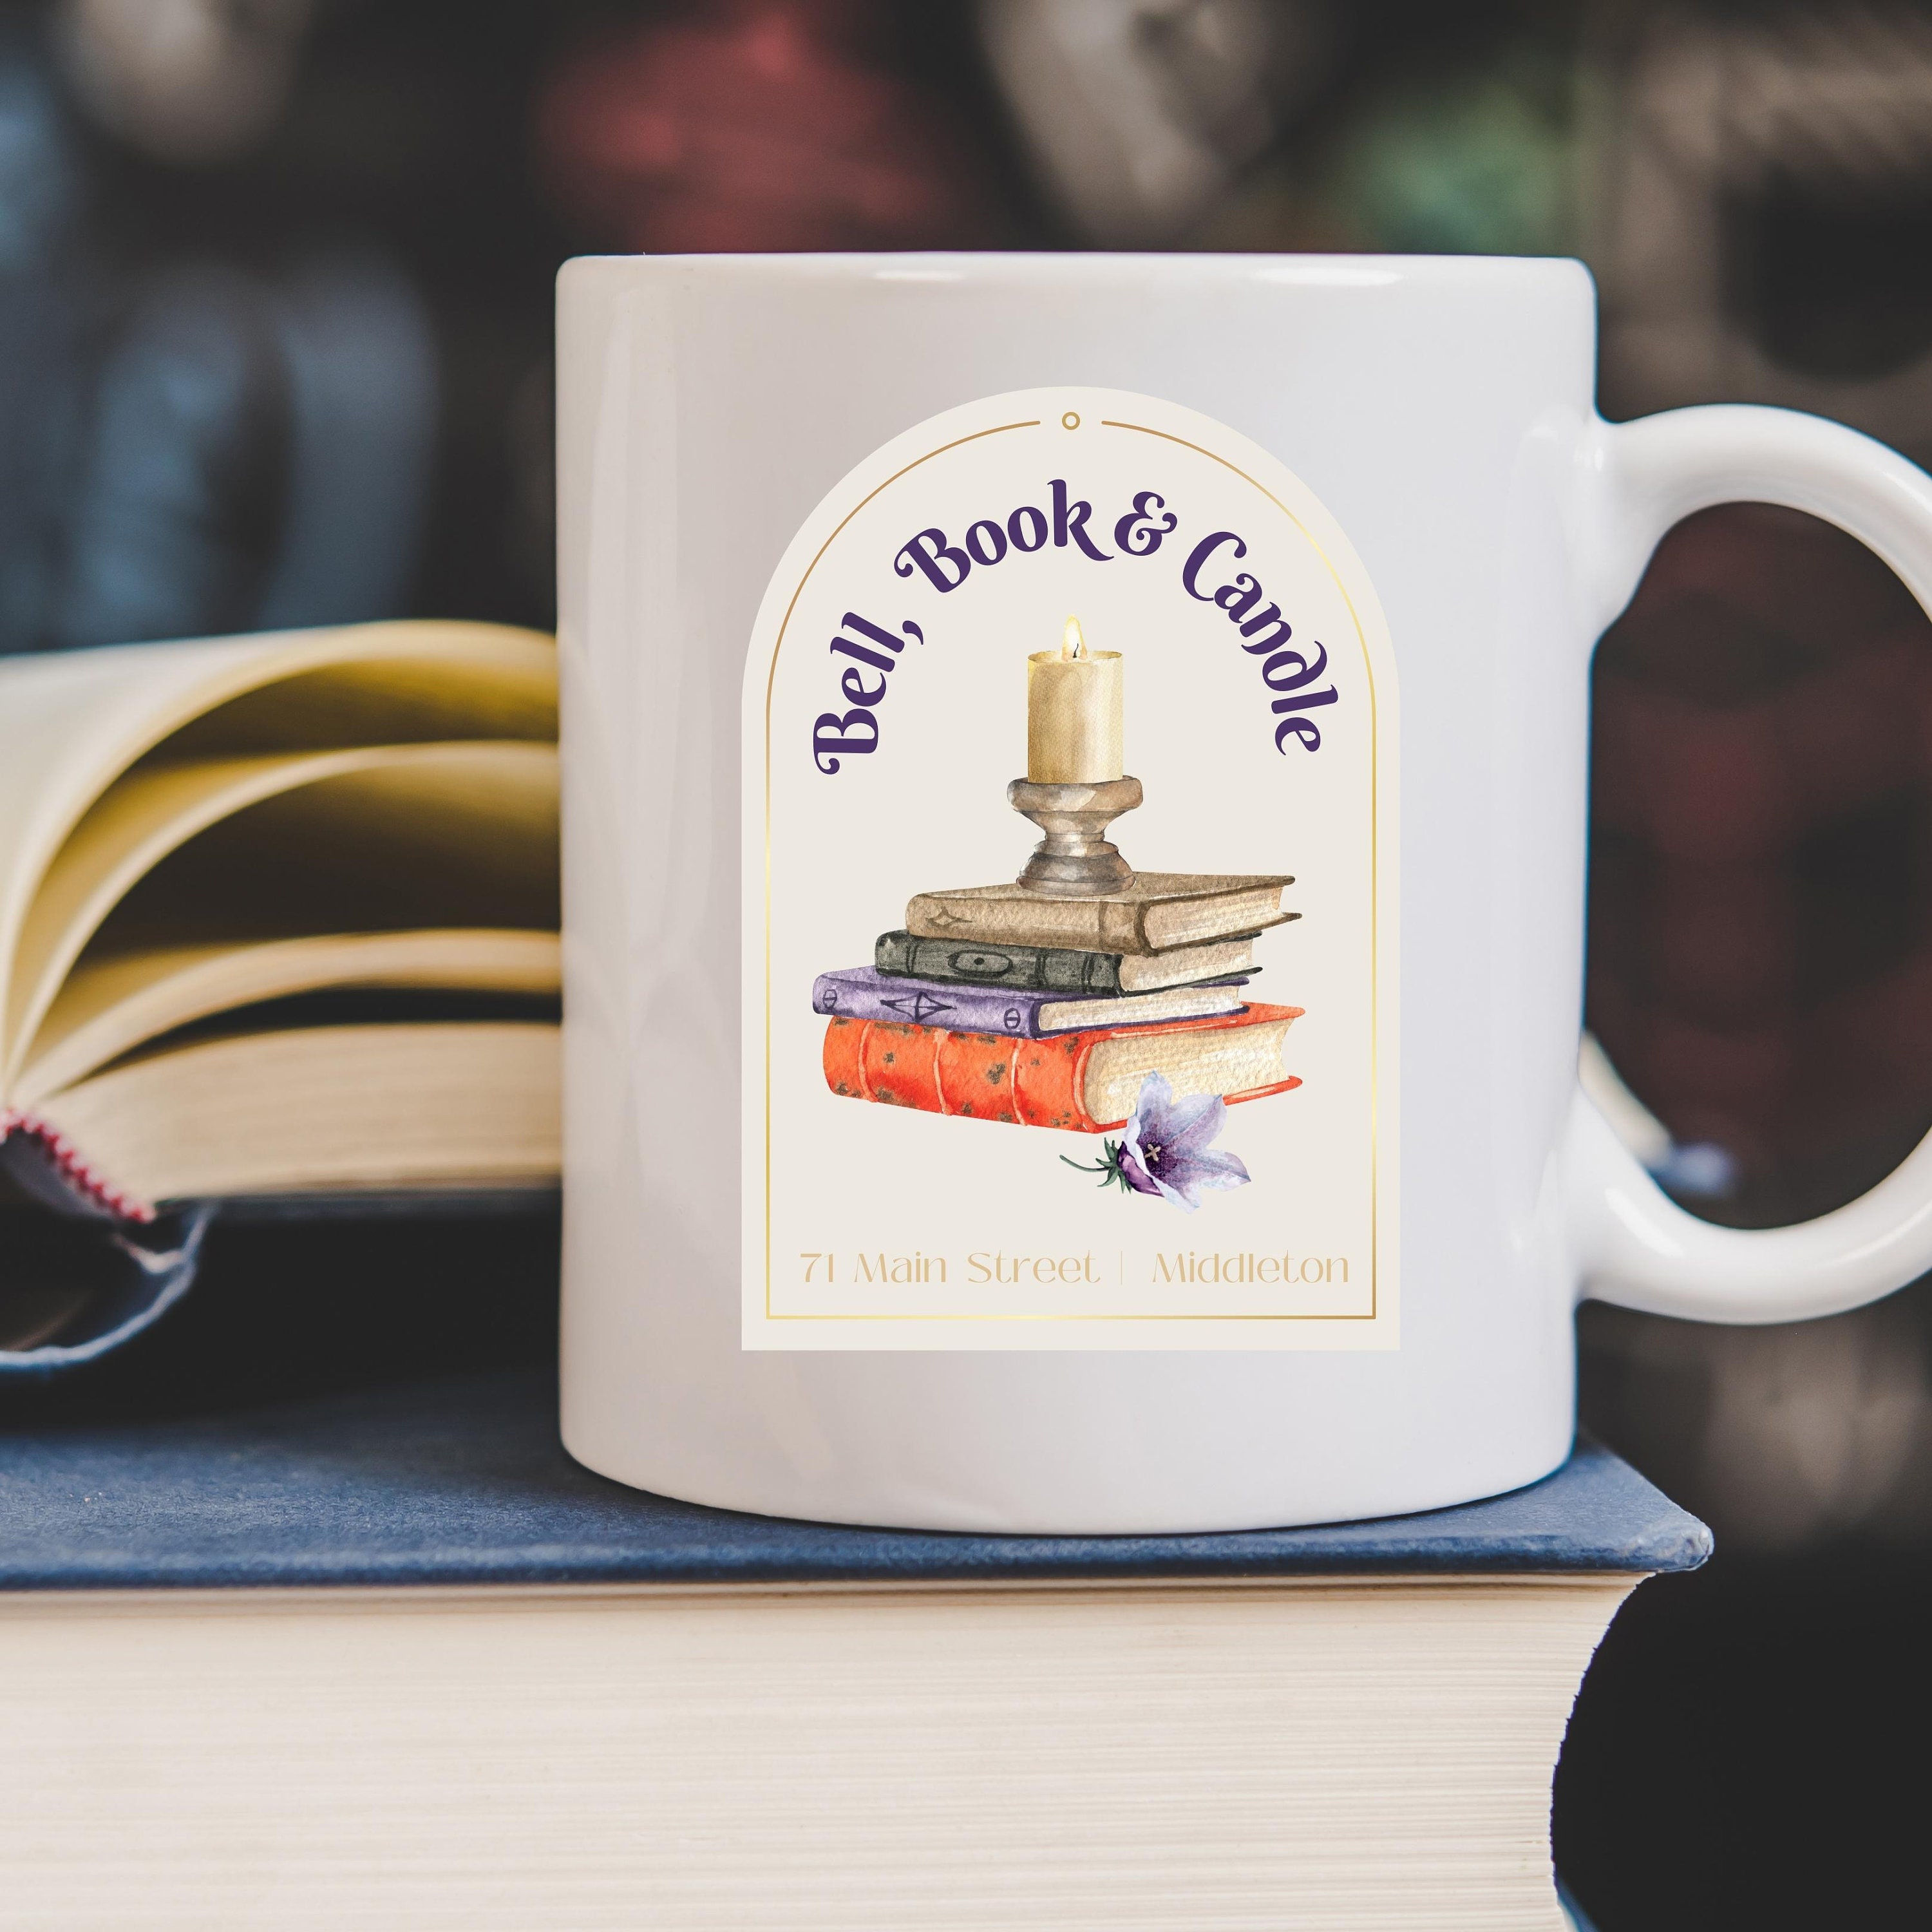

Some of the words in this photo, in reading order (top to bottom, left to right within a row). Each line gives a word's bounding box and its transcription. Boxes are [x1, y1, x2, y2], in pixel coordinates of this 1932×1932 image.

[813, 611, 924, 775] Bell,
[893, 478, 1115, 594] Book
[1113, 491, 1179, 556] &
[1182, 531, 1340, 756] Candle
[800, 1253, 834, 1283] 71
[853, 1251, 947, 1283] Main
[967, 1249, 1101, 1283] Street
[1152, 1249, 1349, 1283] Middleton
